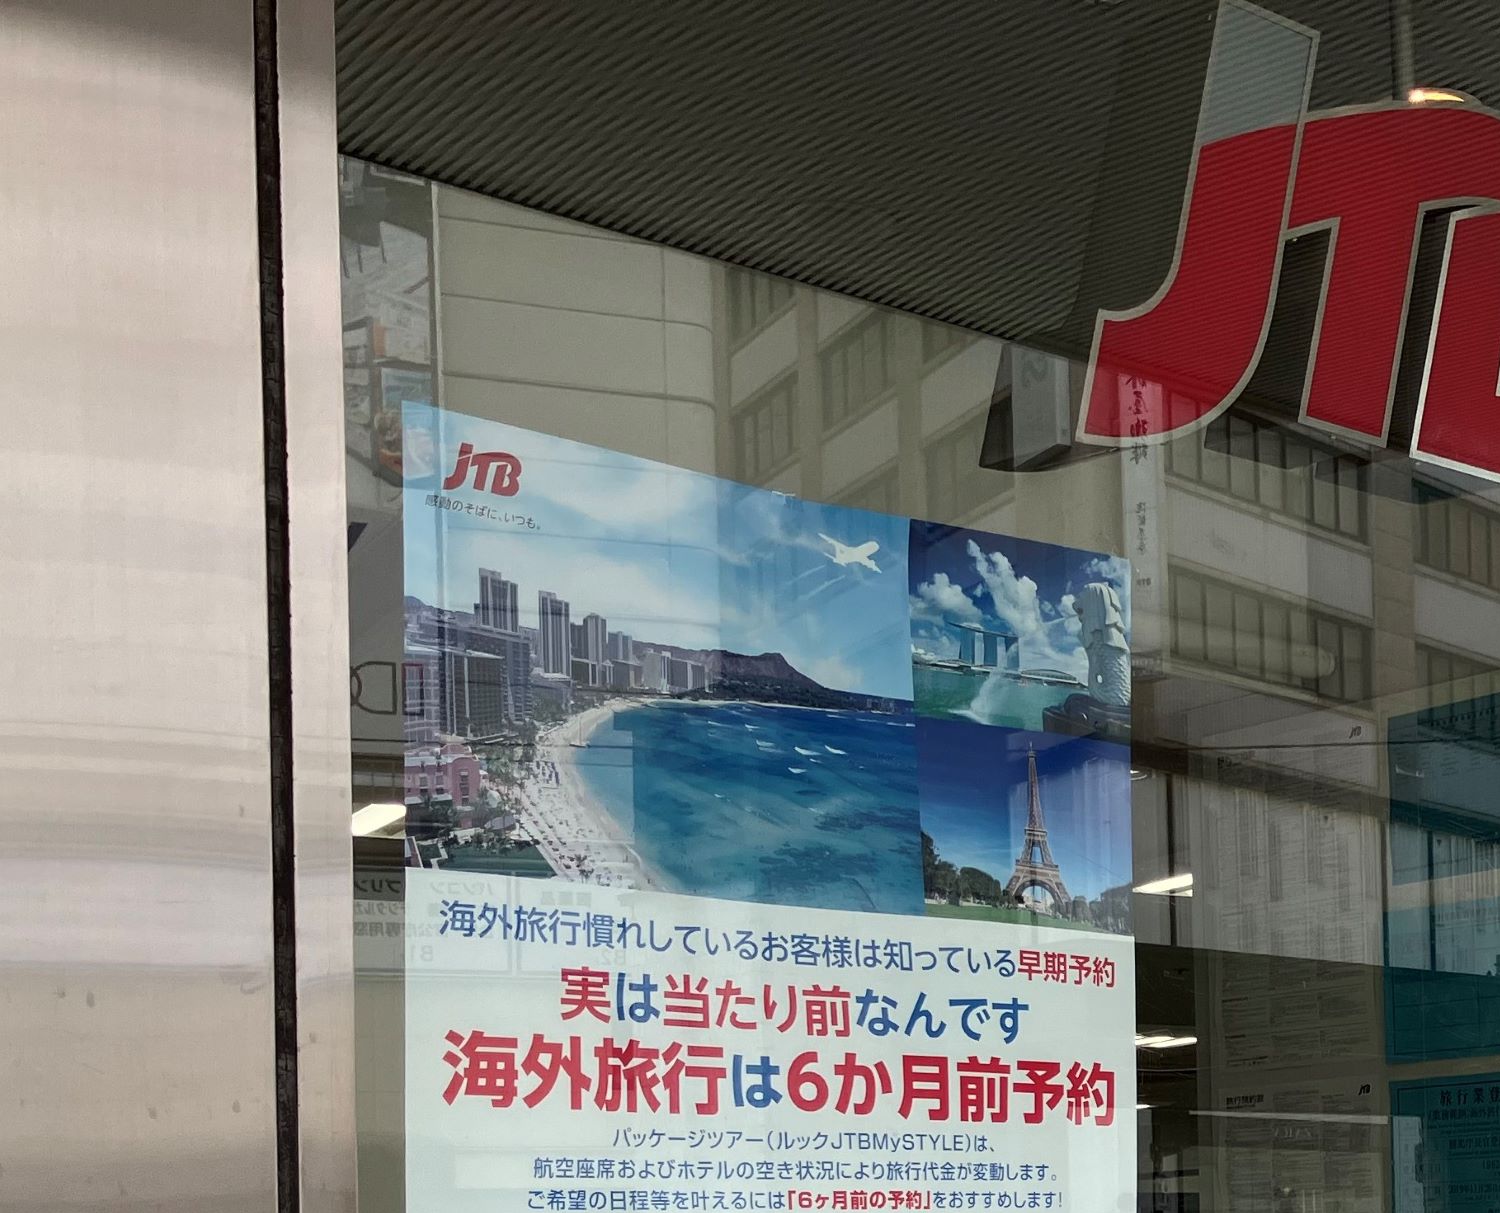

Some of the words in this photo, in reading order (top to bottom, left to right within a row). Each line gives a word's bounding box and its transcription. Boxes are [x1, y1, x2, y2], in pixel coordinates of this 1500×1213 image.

[443, 442, 522, 497] JTB
[425, 494, 541, 530] 感動のそばに、いつも。
[439, 899, 1115, 988] 海外旅行慣れしているお客様は知っている早期予約
[560, 966, 1030, 1045] 実は当たり前なんです
[442, 1029, 1115, 1126] 海外旅行は6か月前予約
[533, 1157, 1057, 1182] 航空座席およびホテルの空き状況により旅行代金が変動します。
